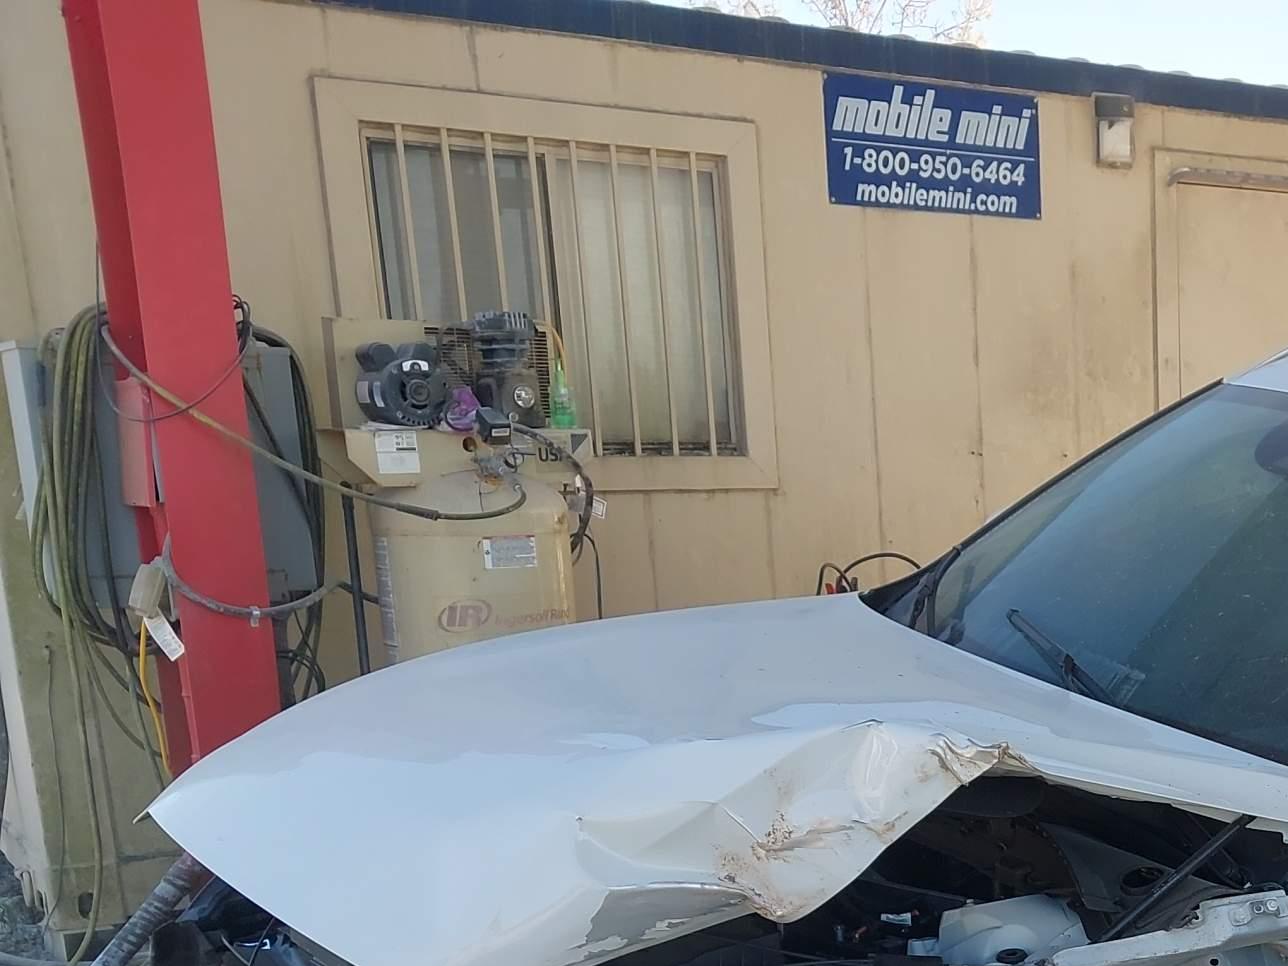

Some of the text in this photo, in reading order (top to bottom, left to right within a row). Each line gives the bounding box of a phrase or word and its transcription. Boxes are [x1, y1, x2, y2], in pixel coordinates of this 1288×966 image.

[832, 85, 1032, 150] mobile mini
[843, 146, 1026, 186] 1-800-950-6464
[856, 181, 1017, 213] mobilemini.com
[537, 447, 563, 462] US
